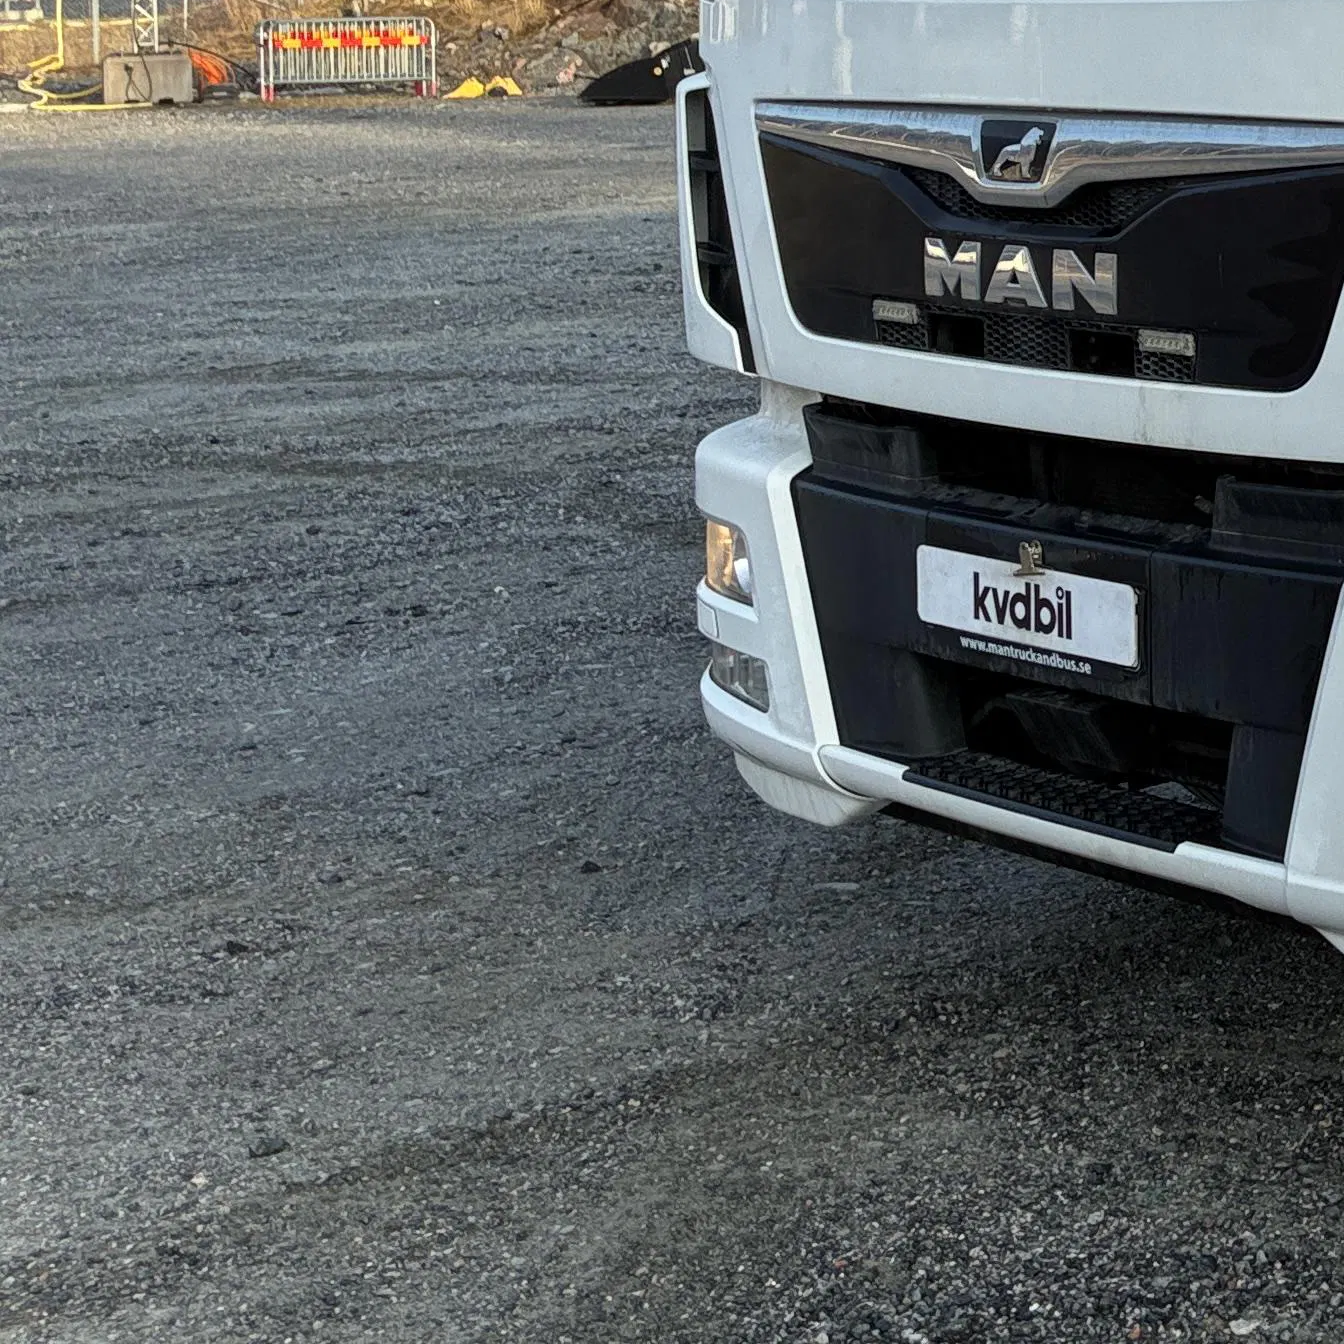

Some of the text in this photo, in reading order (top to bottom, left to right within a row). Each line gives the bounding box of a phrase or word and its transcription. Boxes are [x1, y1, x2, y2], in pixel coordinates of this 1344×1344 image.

[923, 236, 1118, 316] MAN
[972, 571, 1073, 641] kvdbil
[959, 634, 1093, 675] www.mantruckandbus.se
